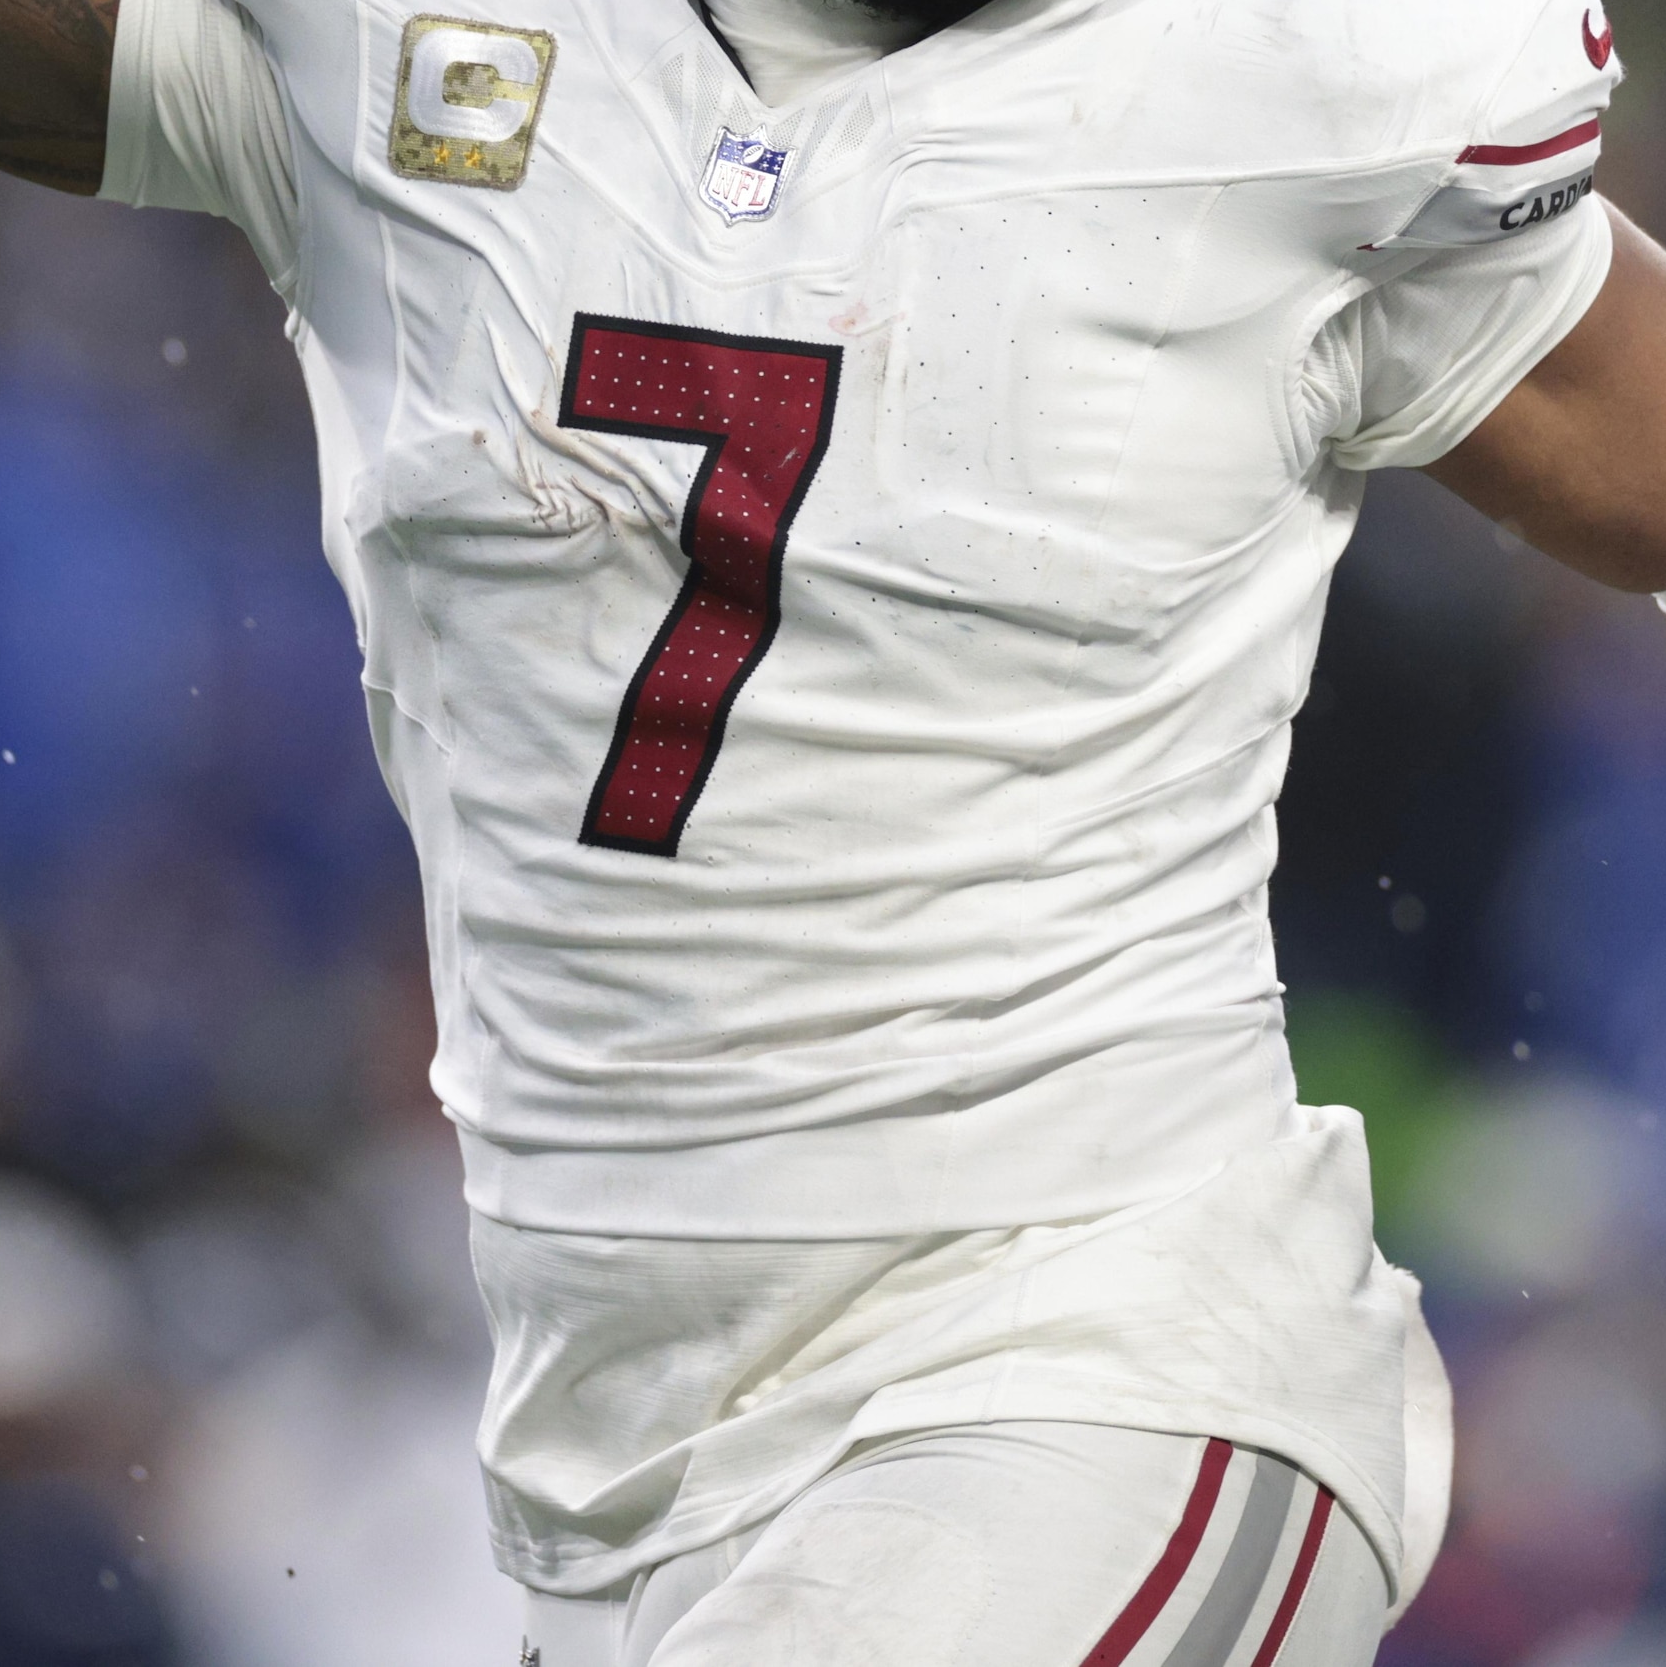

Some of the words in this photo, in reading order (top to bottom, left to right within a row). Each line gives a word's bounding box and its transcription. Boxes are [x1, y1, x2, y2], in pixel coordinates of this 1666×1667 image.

[407, 28, 539, 143] C
[712, 164, 766, 207] NFL
[556, 311, 844, 857] 7
